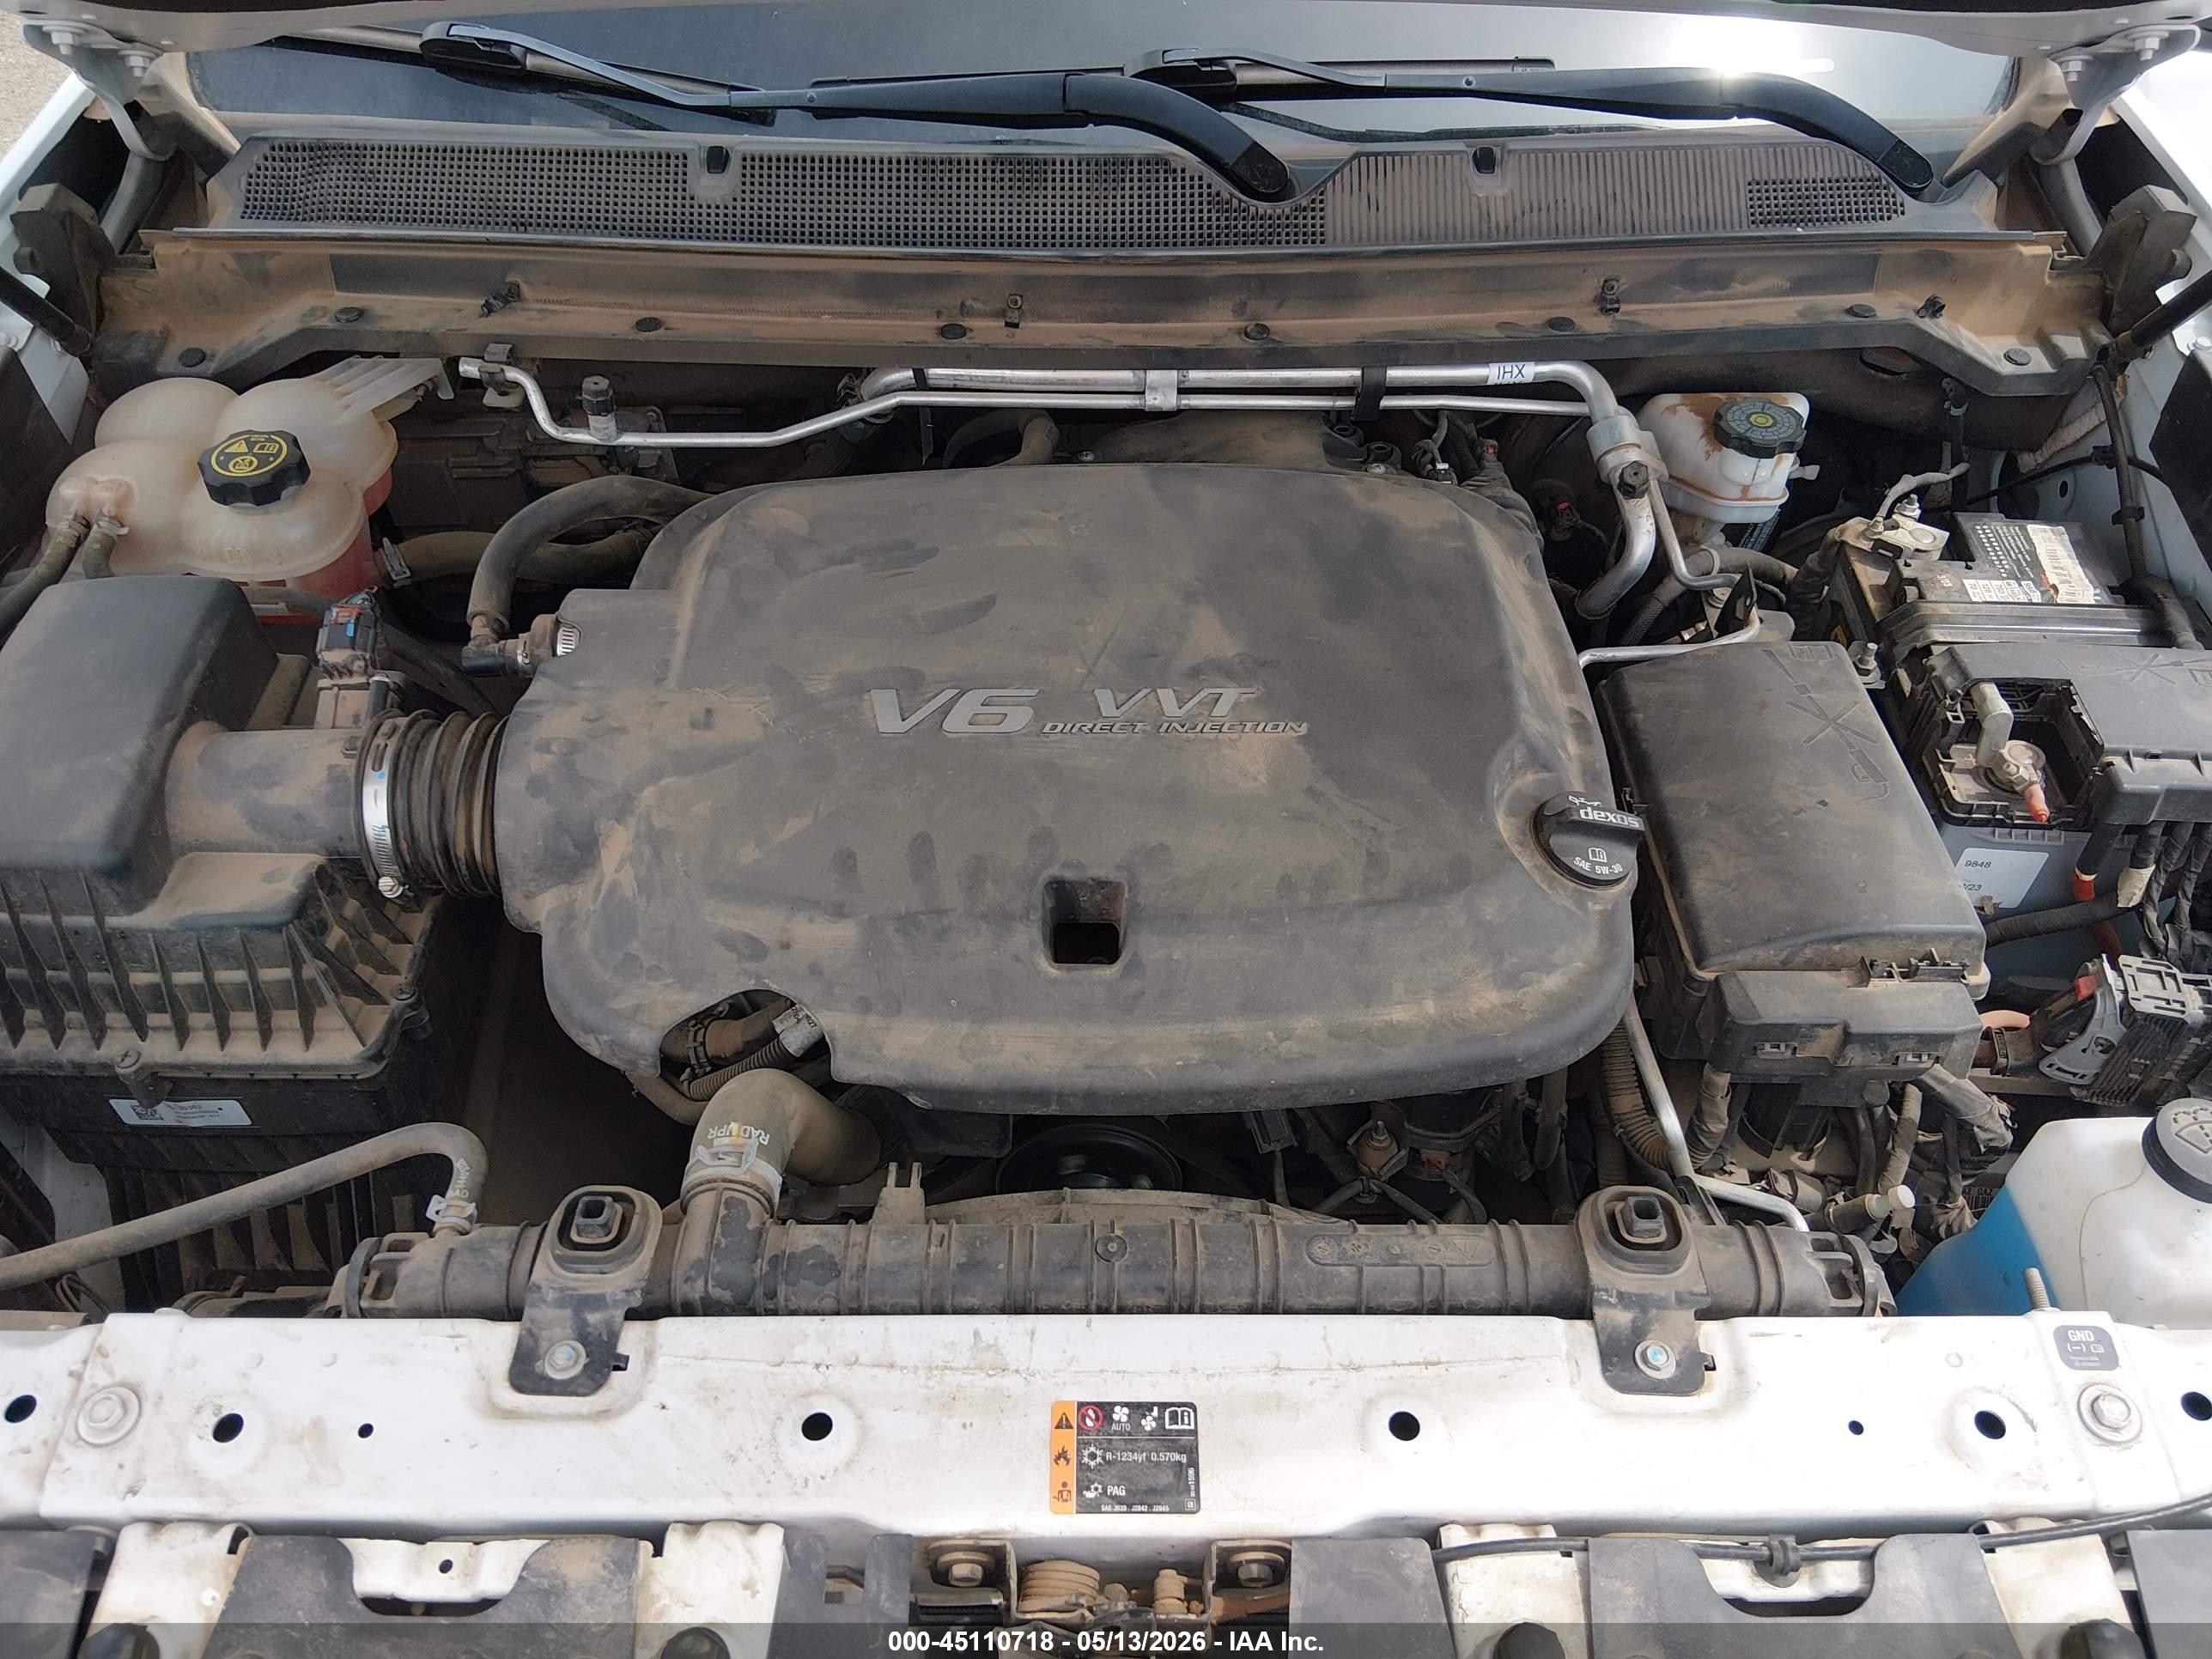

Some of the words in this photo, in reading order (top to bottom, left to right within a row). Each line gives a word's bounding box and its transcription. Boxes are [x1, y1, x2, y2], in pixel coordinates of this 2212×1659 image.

[1497, 363, 1526, 380] IHX
[870, 688, 1040, 734] V6
[1092, 687, 1257, 718] VVT
[1041, 721, 1147, 735] DIRECT
[1157, 720, 1309, 734] INJECTION
[1579, 806, 1640, 827] dexos
[1573, 856, 1592, 872] SAE
[1595, 862, 1623, 874] 5W-30
[1964, 860, 1992, 869] 9848
[2067, 1329, 2095, 1341] GND
[1111, 1423, 1131, 1431] AUTO
[1151, 1451, 1187, 1463] 0.570kg
[1107, 1485, 1126, 1497] PAG
